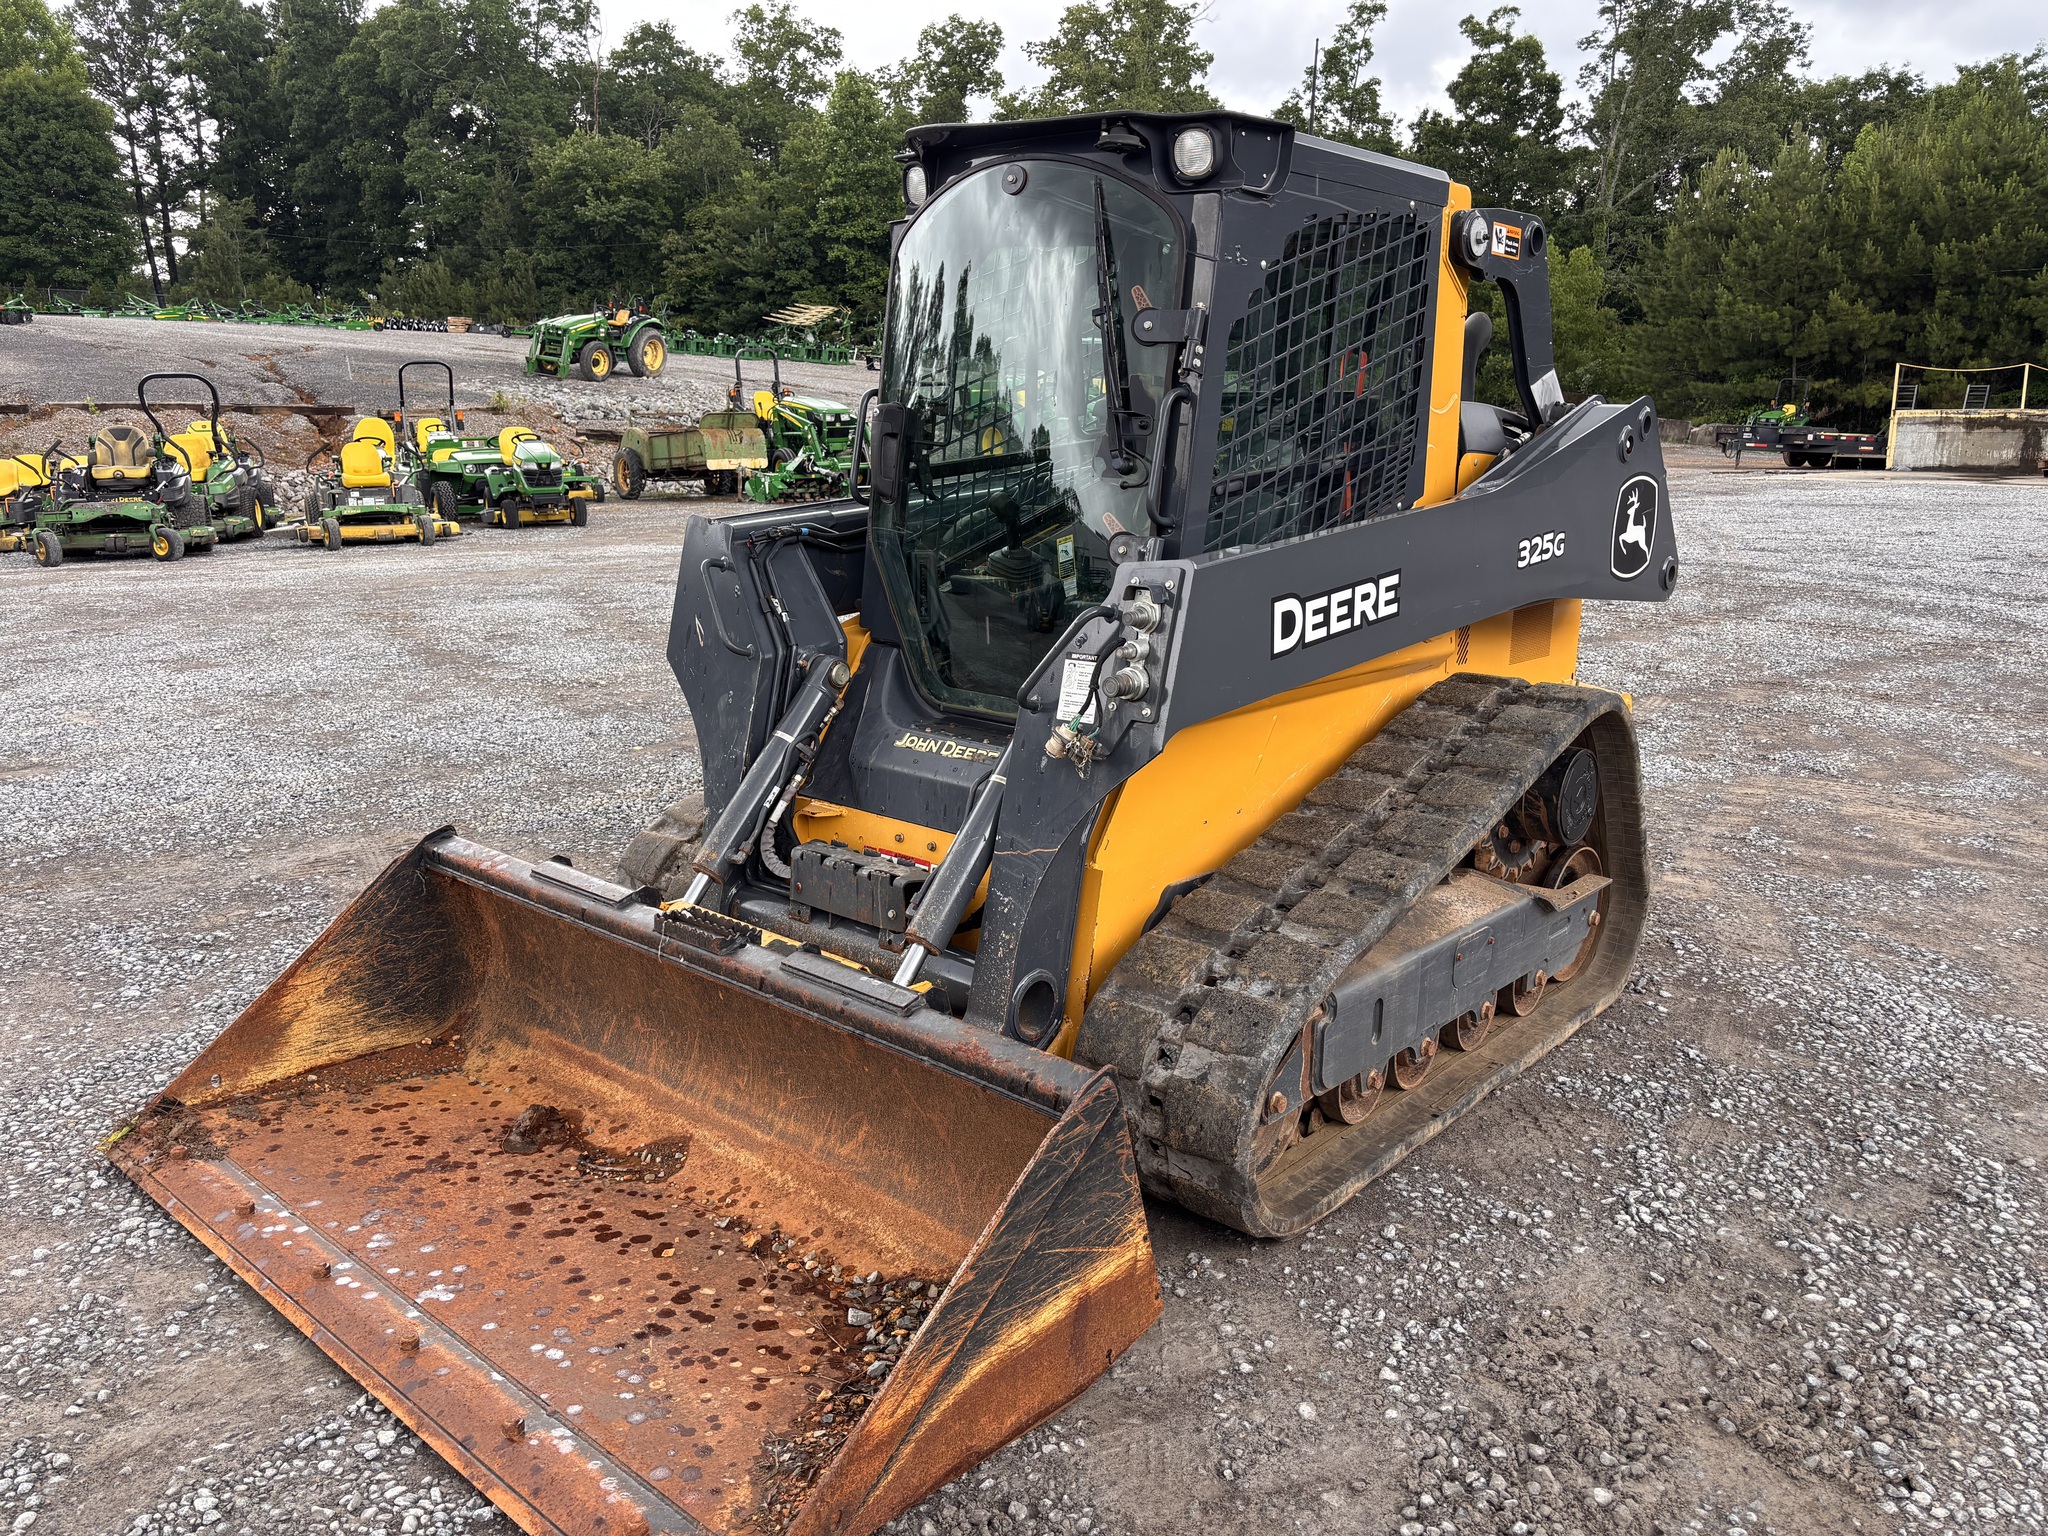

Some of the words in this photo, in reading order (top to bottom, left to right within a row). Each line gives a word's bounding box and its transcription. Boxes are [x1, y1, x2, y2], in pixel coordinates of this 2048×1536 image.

[1517, 531, 1567, 569] 325G
[1272, 572, 1400, 655] DEERE
[1071, 653, 1098, 661] IMPORTANT
[894, 732, 941, 754] JOHN
